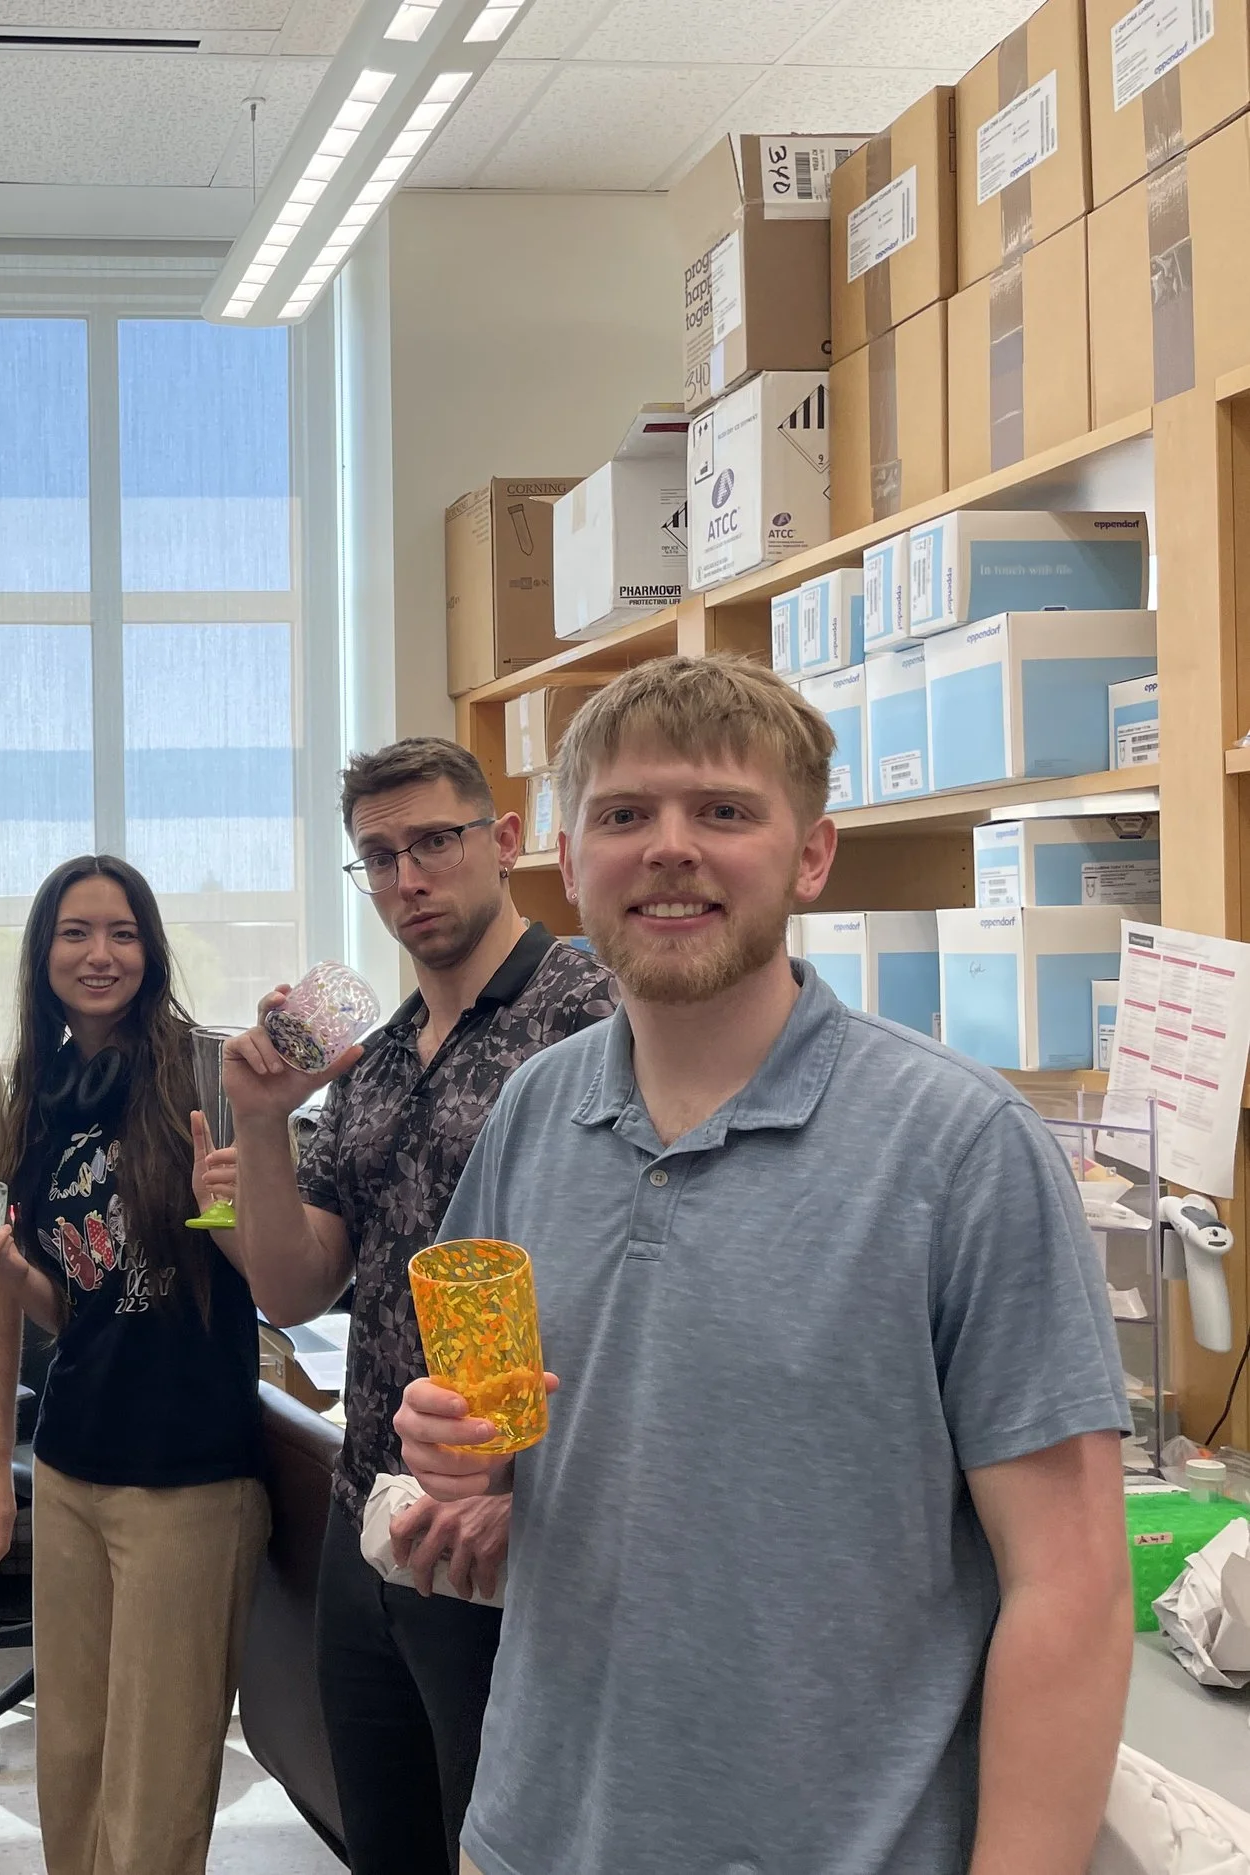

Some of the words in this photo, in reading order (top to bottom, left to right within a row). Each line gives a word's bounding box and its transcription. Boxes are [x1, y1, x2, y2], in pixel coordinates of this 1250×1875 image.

[1154, 40, 1188, 75] eppendorf
[768, 145, 791, 194] 340
[685, 361, 711, 401] 340
[507, 483, 566, 494] CORNING
[707, 509, 738, 542] ATCC
[1094, 520, 1140, 530] eppendorf
[768, 529, 794, 538] ATCC
[966, 624, 1001, 644] eppendorf
[833, 673, 860, 688] eppendorf
[1144, 683, 1158, 693] epp
[980, 916, 1016, 928] eppendorf
